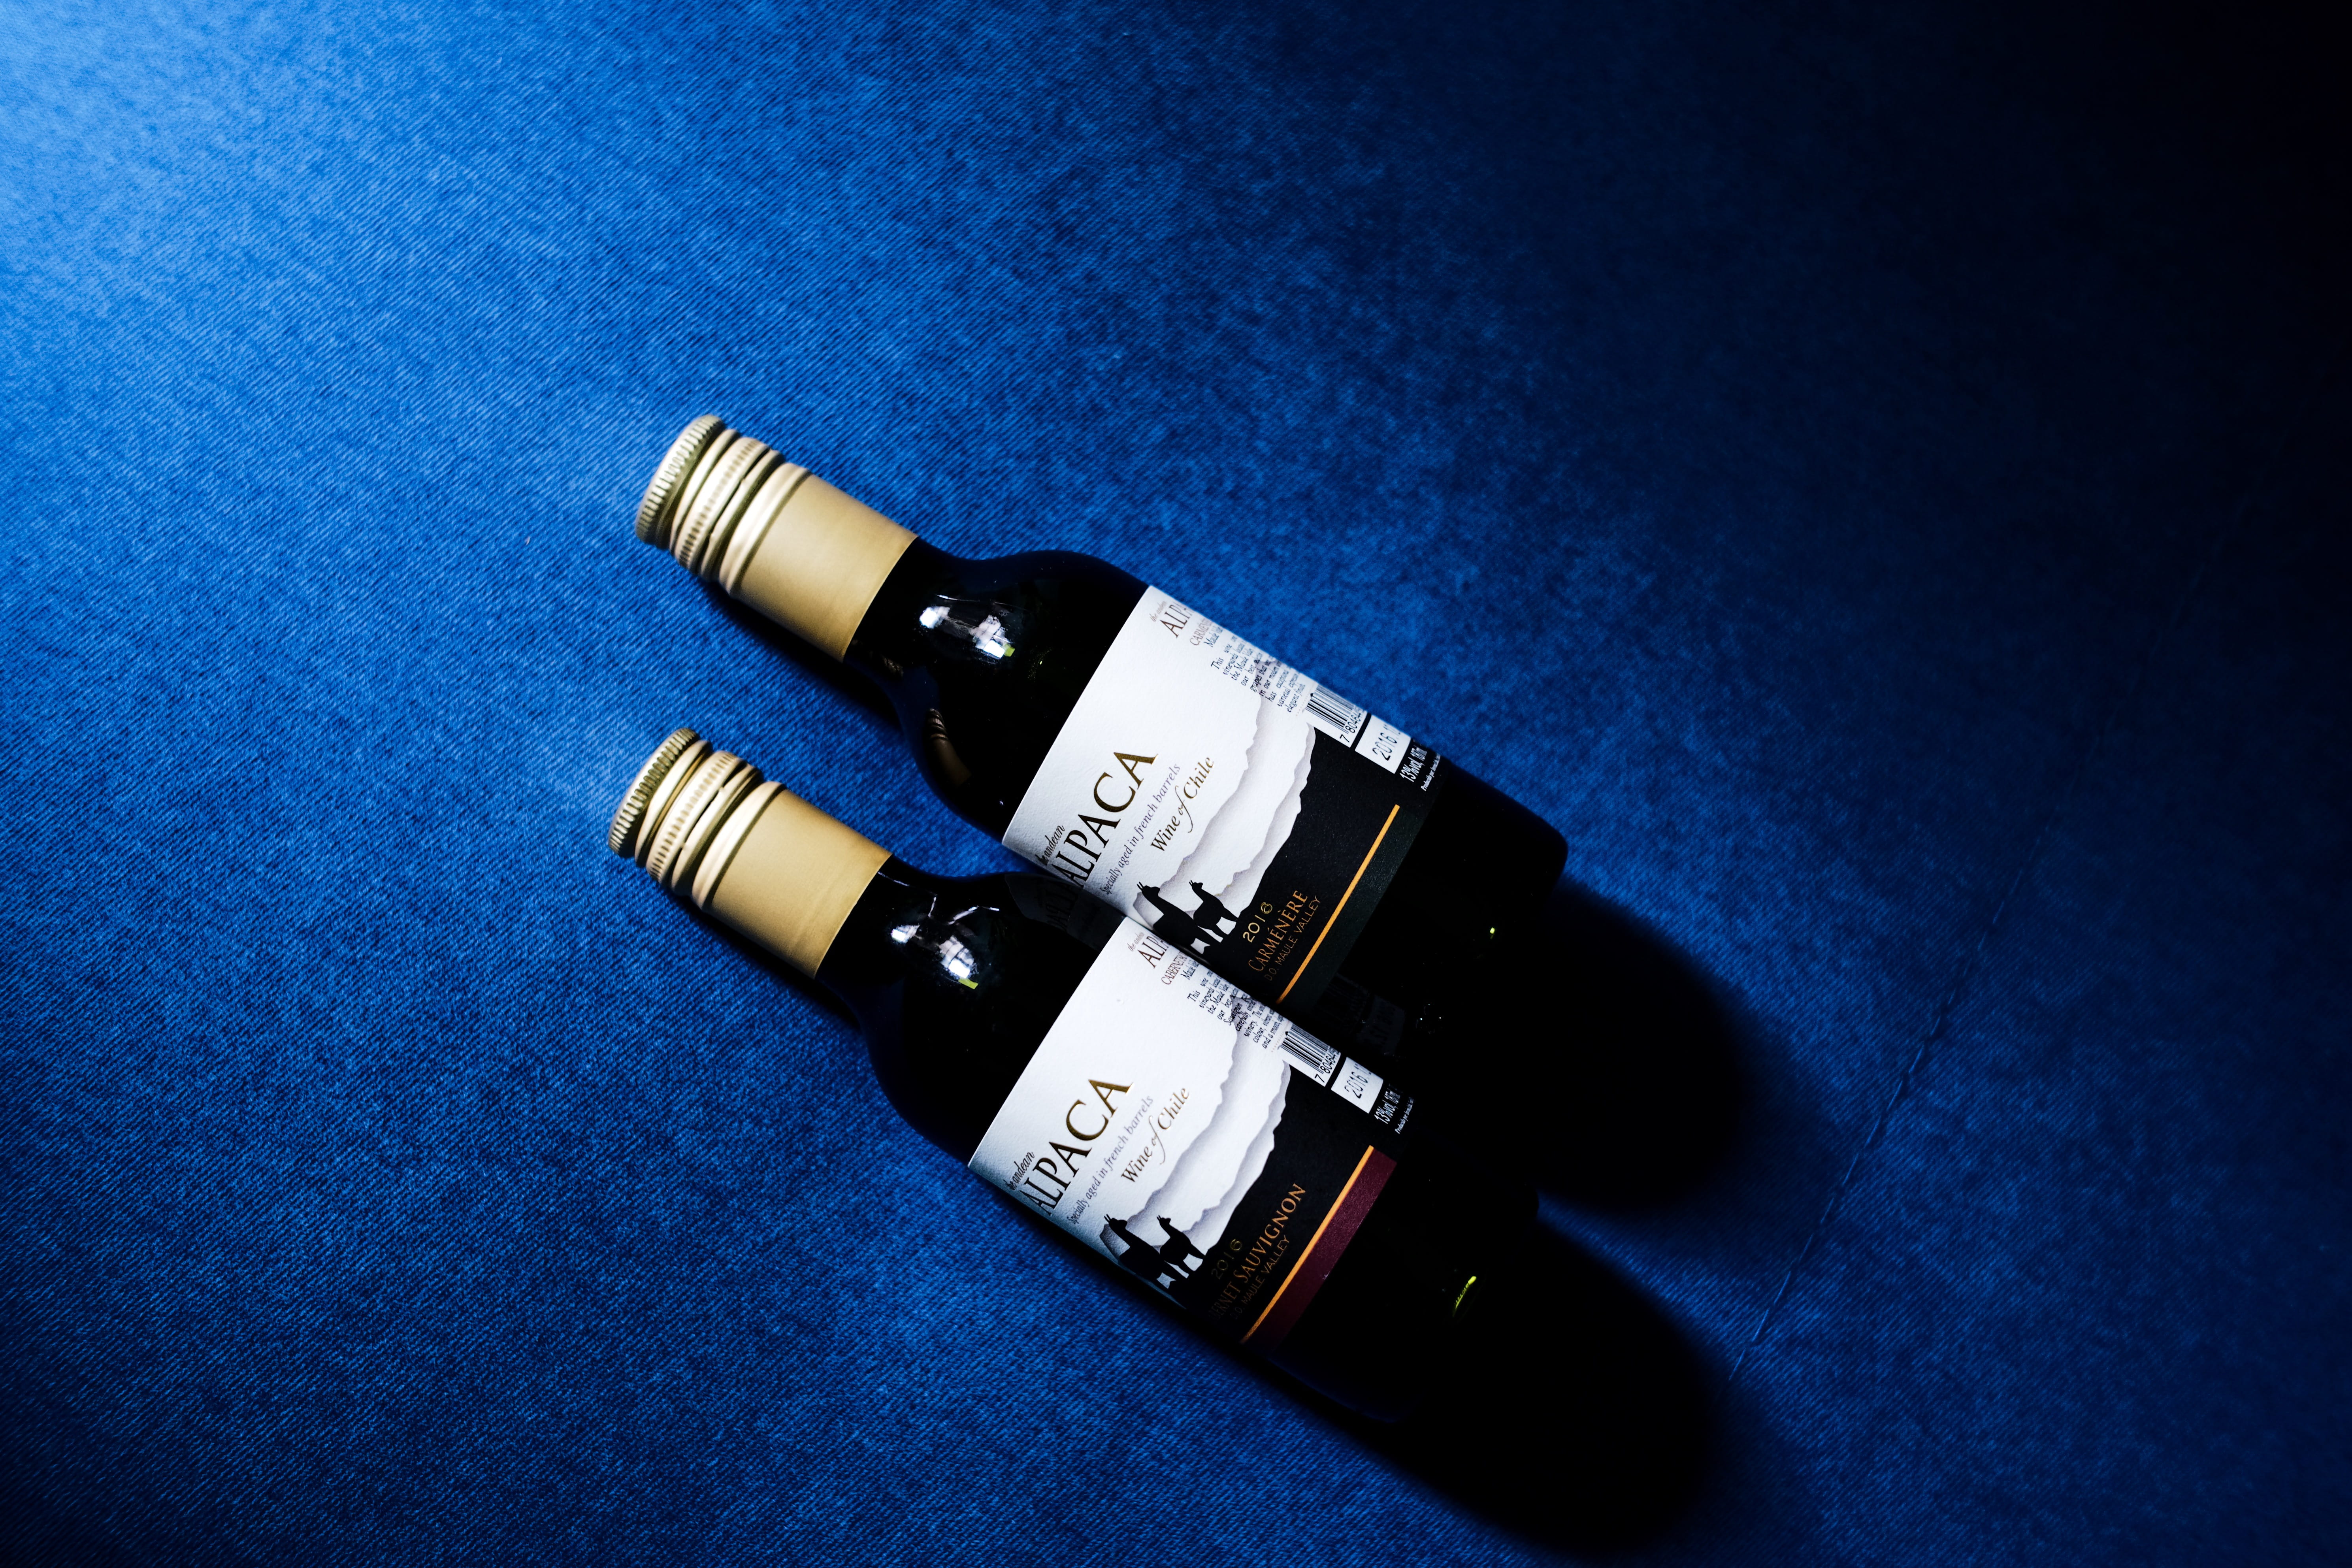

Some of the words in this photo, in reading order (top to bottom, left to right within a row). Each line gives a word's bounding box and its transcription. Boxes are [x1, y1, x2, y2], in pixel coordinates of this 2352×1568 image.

[1211, 658, 1223, 669] This
[1223, 654, 1238, 675] vineyards
[1234, 657, 1249, 672] Maule
[1230, 671, 1240, 680] the
[1249, 673, 1263, 693] grapes
[1256, 687, 1266, 697] in
[1263, 678, 1271, 690] our
[1265, 692, 1277, 702] has
[1277, 689, 1291, 707] varietal
[1284, 694, 1299, 712] elegant
[1340, 734, 1349, 743] 7
[1400, 757, 1425, 782] 13%vol,
[1150, 816, 1180, 851] Wine
[1175, 786, 1193, 833] of
[1184, 758, 1214, 799] Chile
[1048, 752, 1155, 893] ALPACA
[1099, 867, 1122, 899] Specially
[1118, 844, 1133, 868] aged
[1127, 836, 1138, 847] in
[1135, 804, 1157, 839] french
[1152, 764, 1180, 803] barrels
[1041, 825, 1065, 859] andean
[1243, 902, 1272, 942] 2016
[1248, 890, 1308, 971] CARMÉNÈRE
[1275, 935, 1298, 965] MAULE
[1293, 895, 1320, 933] VALLEY
[1187, 990, 1200, 1002] This
[1199, 987, 1215, 1008] vineyards
[1210, 991, 1225, 1006] Maule
[1206, 1005, 1216, 1014] the
[1234, 1010, 1251, 1032] carefully
[1244, 1021, 1258, 1037] winery.
[1253, 1027, 1266, 1043] colour,
[1262, 1037, 1271, 1049] and
[1314, 1074, 1325, 1083] 7
[1374, 1100, 1397, 1124] 13%vol,
[1121, 1147, 1152, 1182] Wine
[1148, 1116, 1166, 1165] of
[1157, 1088, 1188, 1130] Chile
[1017, 1080, 1130, 1218] ALPACA
[1010, 1152, 1035, 1184] andean
[1067, 1200, 1089, 1227] Specially
[1086, 1176, 1101, 1200] aged
[1096, 1168, 1108, 1178] in
[1104, 1136, 1128, 1171] french
[1123, 1096, 1153, 1135] barrels
[1235, 1183, 1306, 1282] SAUVIGNON
[1211, 1239, 1242, 1279] 2016
[1241, 1275, 1265, 1304] MAULE
[1261, 1235, 1289, 1273] VALLEY
